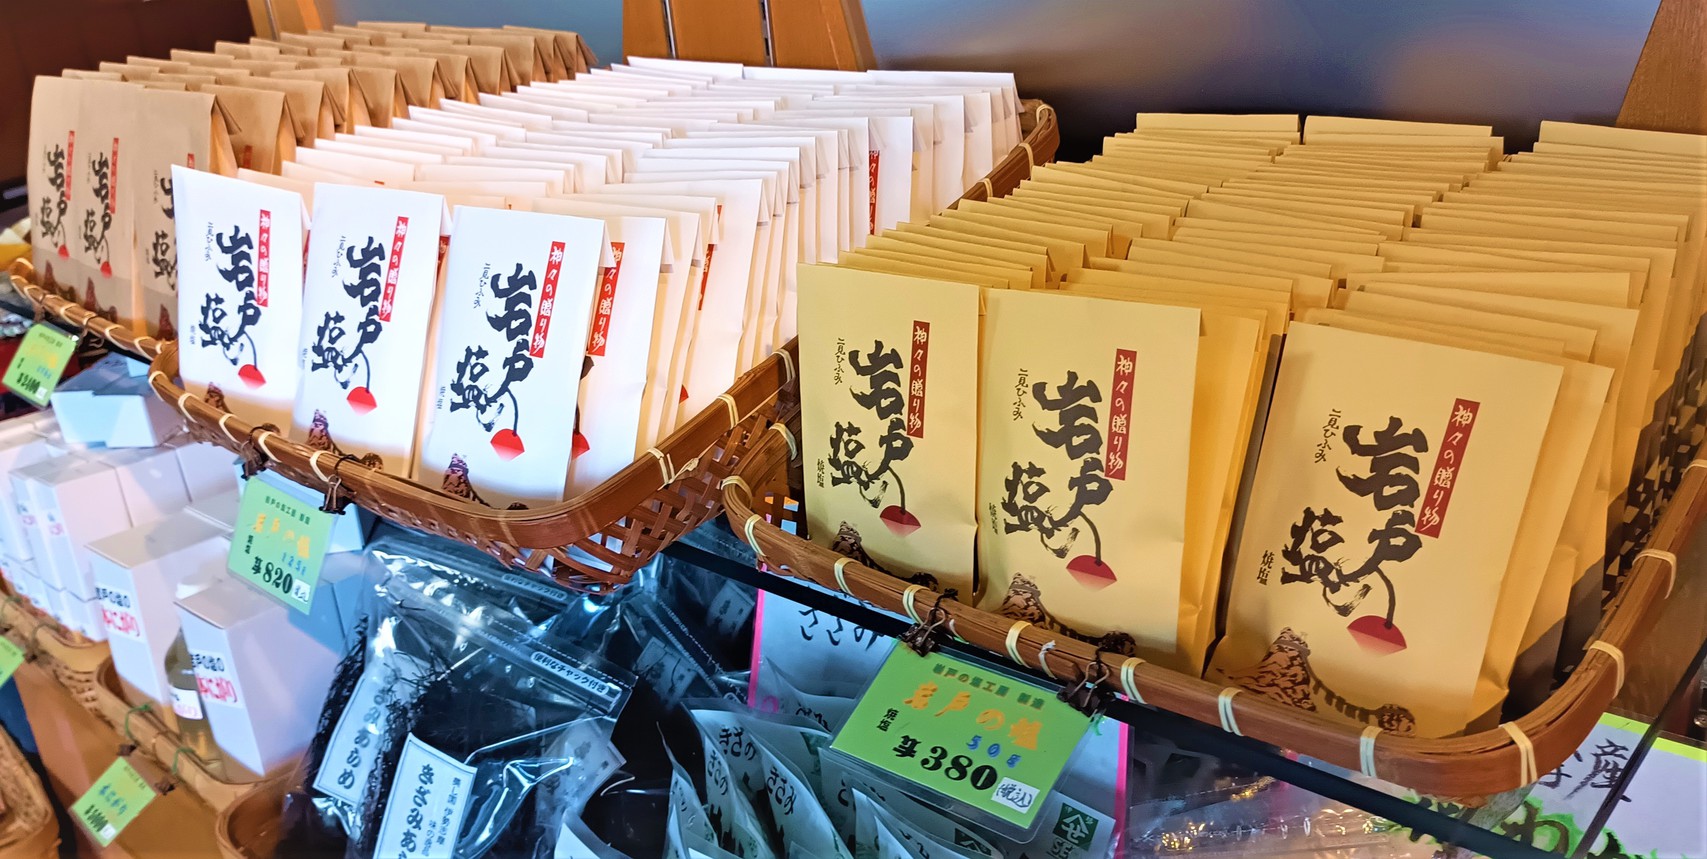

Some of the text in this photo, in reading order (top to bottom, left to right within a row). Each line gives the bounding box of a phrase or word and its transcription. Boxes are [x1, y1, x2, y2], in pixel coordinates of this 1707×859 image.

[532, 246, 563, 354] 神々の贈り物
[909, 325, 928, 434] 神々の贈り物
[1108, 354, 1134, 475] 神々の贈り物
[1420, 404, 1474, 532] 神々の贈り物
[533, 653, 607, 694] 便利なチャック付き
[876, 707, 899, 732] 焼塩
